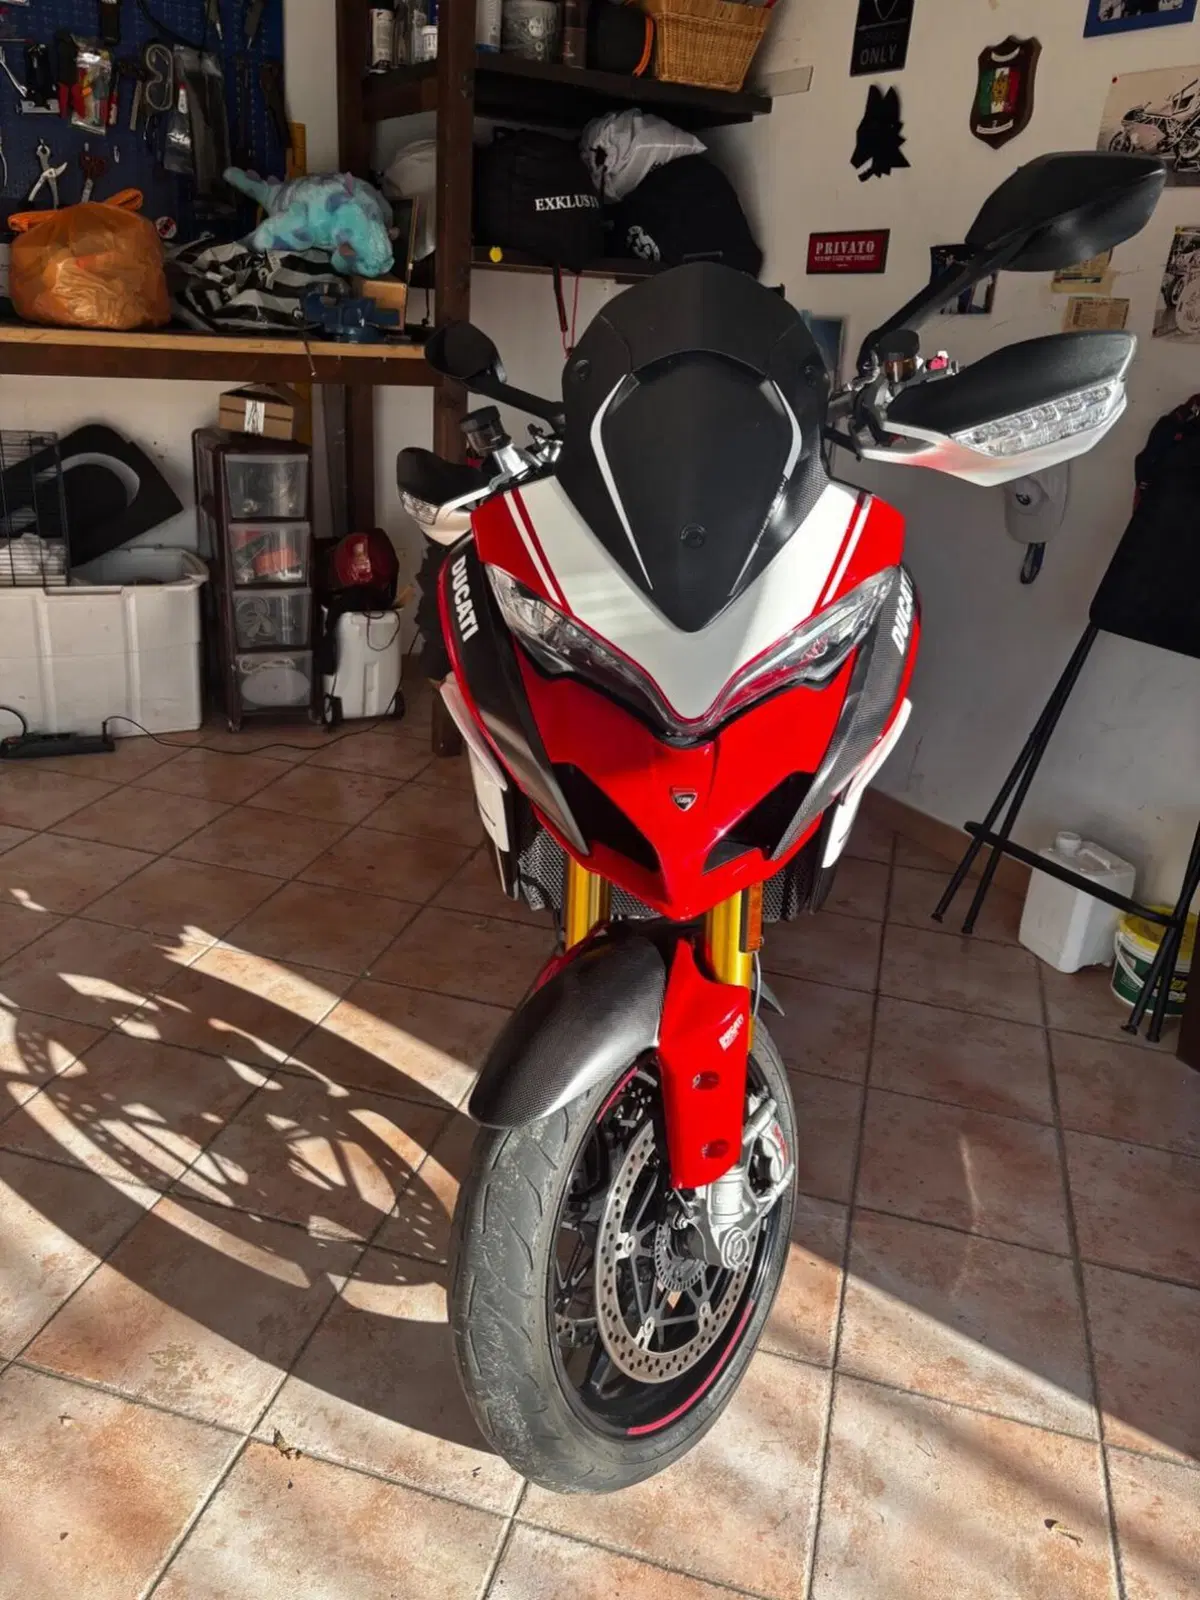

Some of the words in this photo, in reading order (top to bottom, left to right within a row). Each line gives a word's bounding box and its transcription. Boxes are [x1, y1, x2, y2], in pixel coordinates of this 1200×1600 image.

[860, 44, 898, 65] ONLY
[815, 240, 876, 255] PRIVATO
[452, 555, 479, 642] DUCATI
